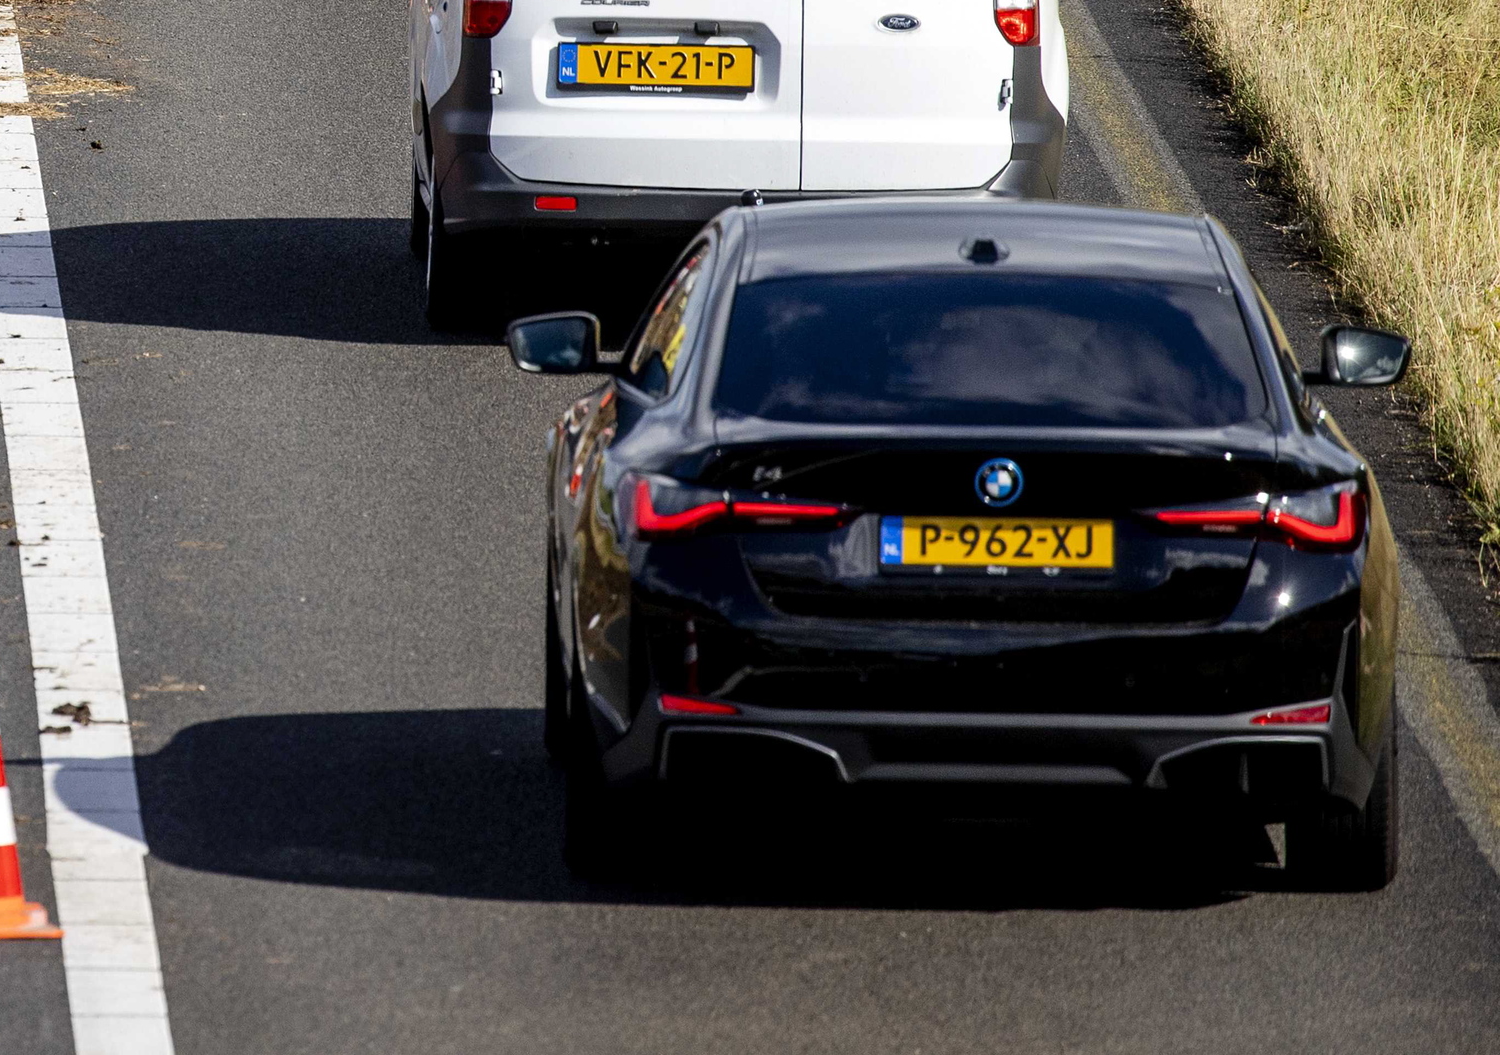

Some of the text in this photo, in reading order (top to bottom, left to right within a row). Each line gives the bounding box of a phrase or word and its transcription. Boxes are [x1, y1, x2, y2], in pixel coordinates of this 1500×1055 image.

[562, 67, 575, 76] NL
[593, 49, 736, 80] VFK-21-P
[884, 544, 899, 555] NL
[920, 523, 1094, 559] P-962-XJ
